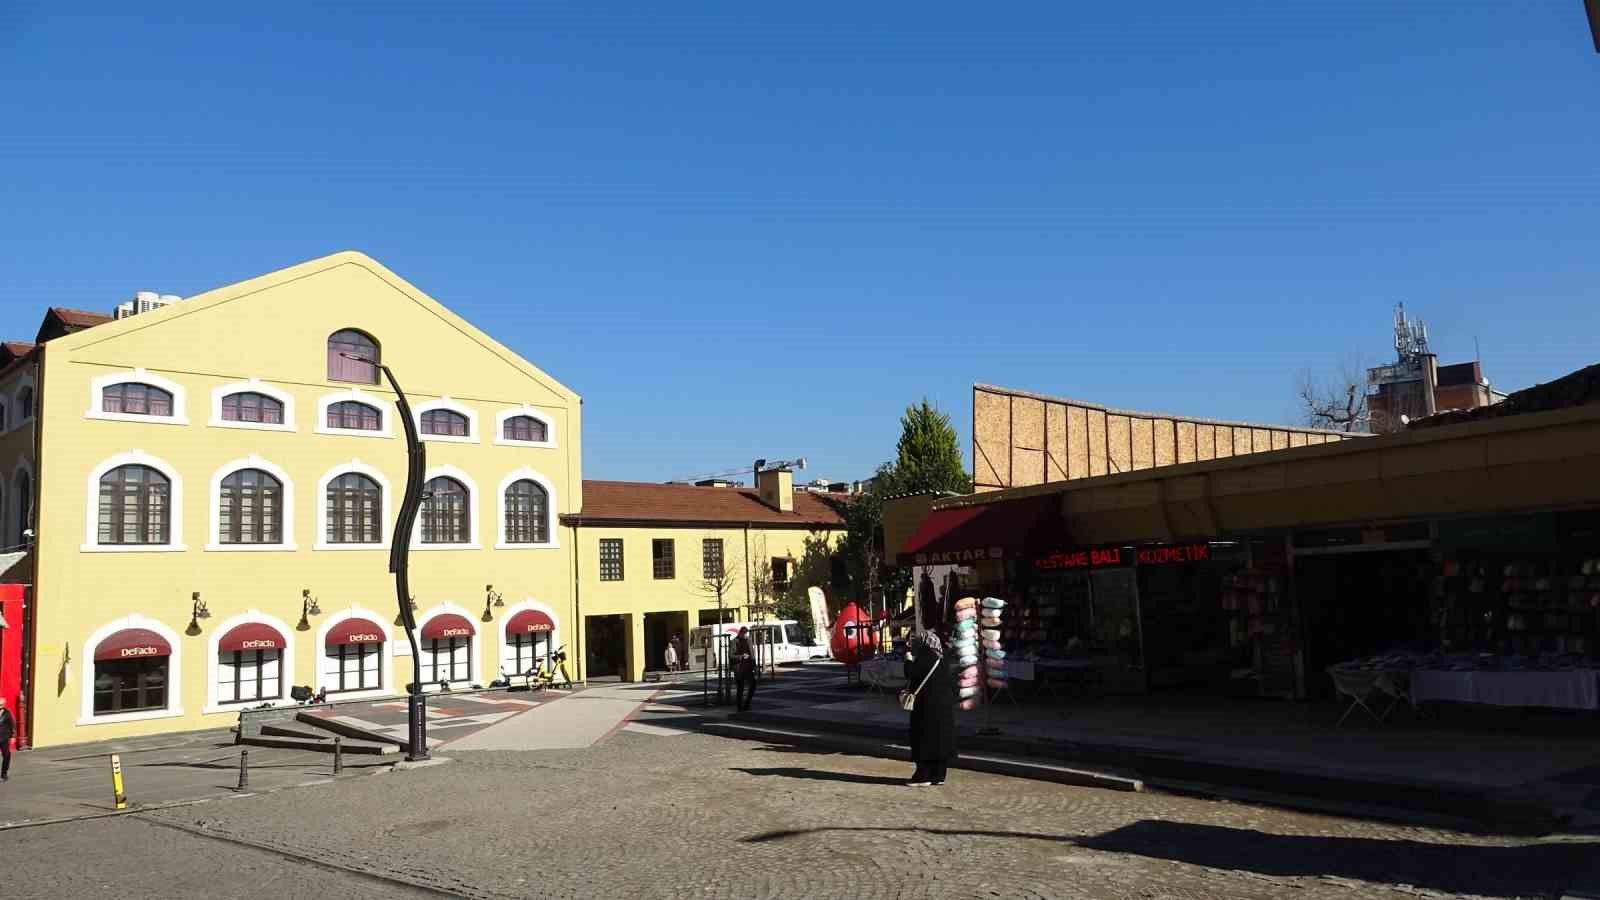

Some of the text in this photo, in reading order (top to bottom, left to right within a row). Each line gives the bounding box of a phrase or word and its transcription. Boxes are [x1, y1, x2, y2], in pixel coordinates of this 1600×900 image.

[931, 548, 985, 562] AKTAR
[349, 633, 377, 642] DeFacto
[443, 628, 469, 637] DeFacto
[242, 639, 275, 649] DeFacto
[121, 646, 157, 657] DeFacto
